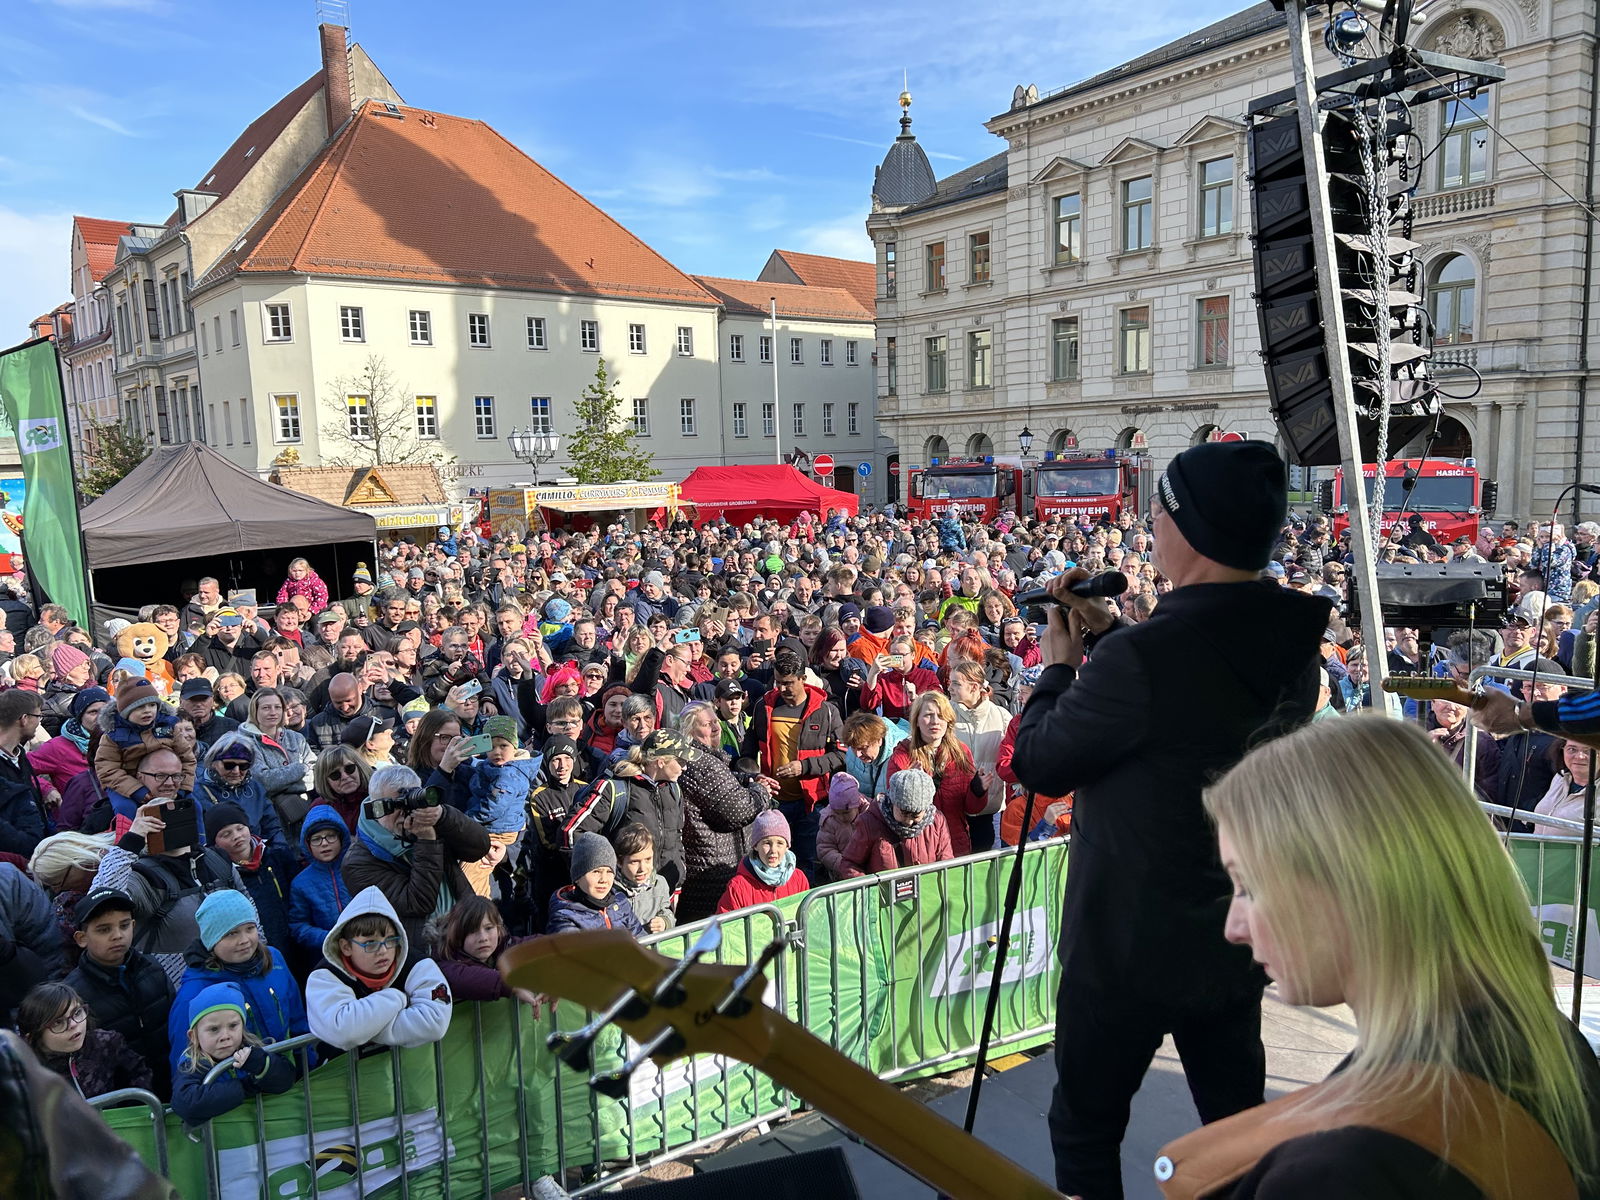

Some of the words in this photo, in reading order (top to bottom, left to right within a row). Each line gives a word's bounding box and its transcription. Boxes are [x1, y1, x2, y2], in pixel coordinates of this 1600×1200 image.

[580, 488, 629, 499] CURRYWURST
[637, 486, 668, 495] POMMES
[930, 503, 987, 513] FEUWEHR
[376, 513, 438, 527] alzkuchen
